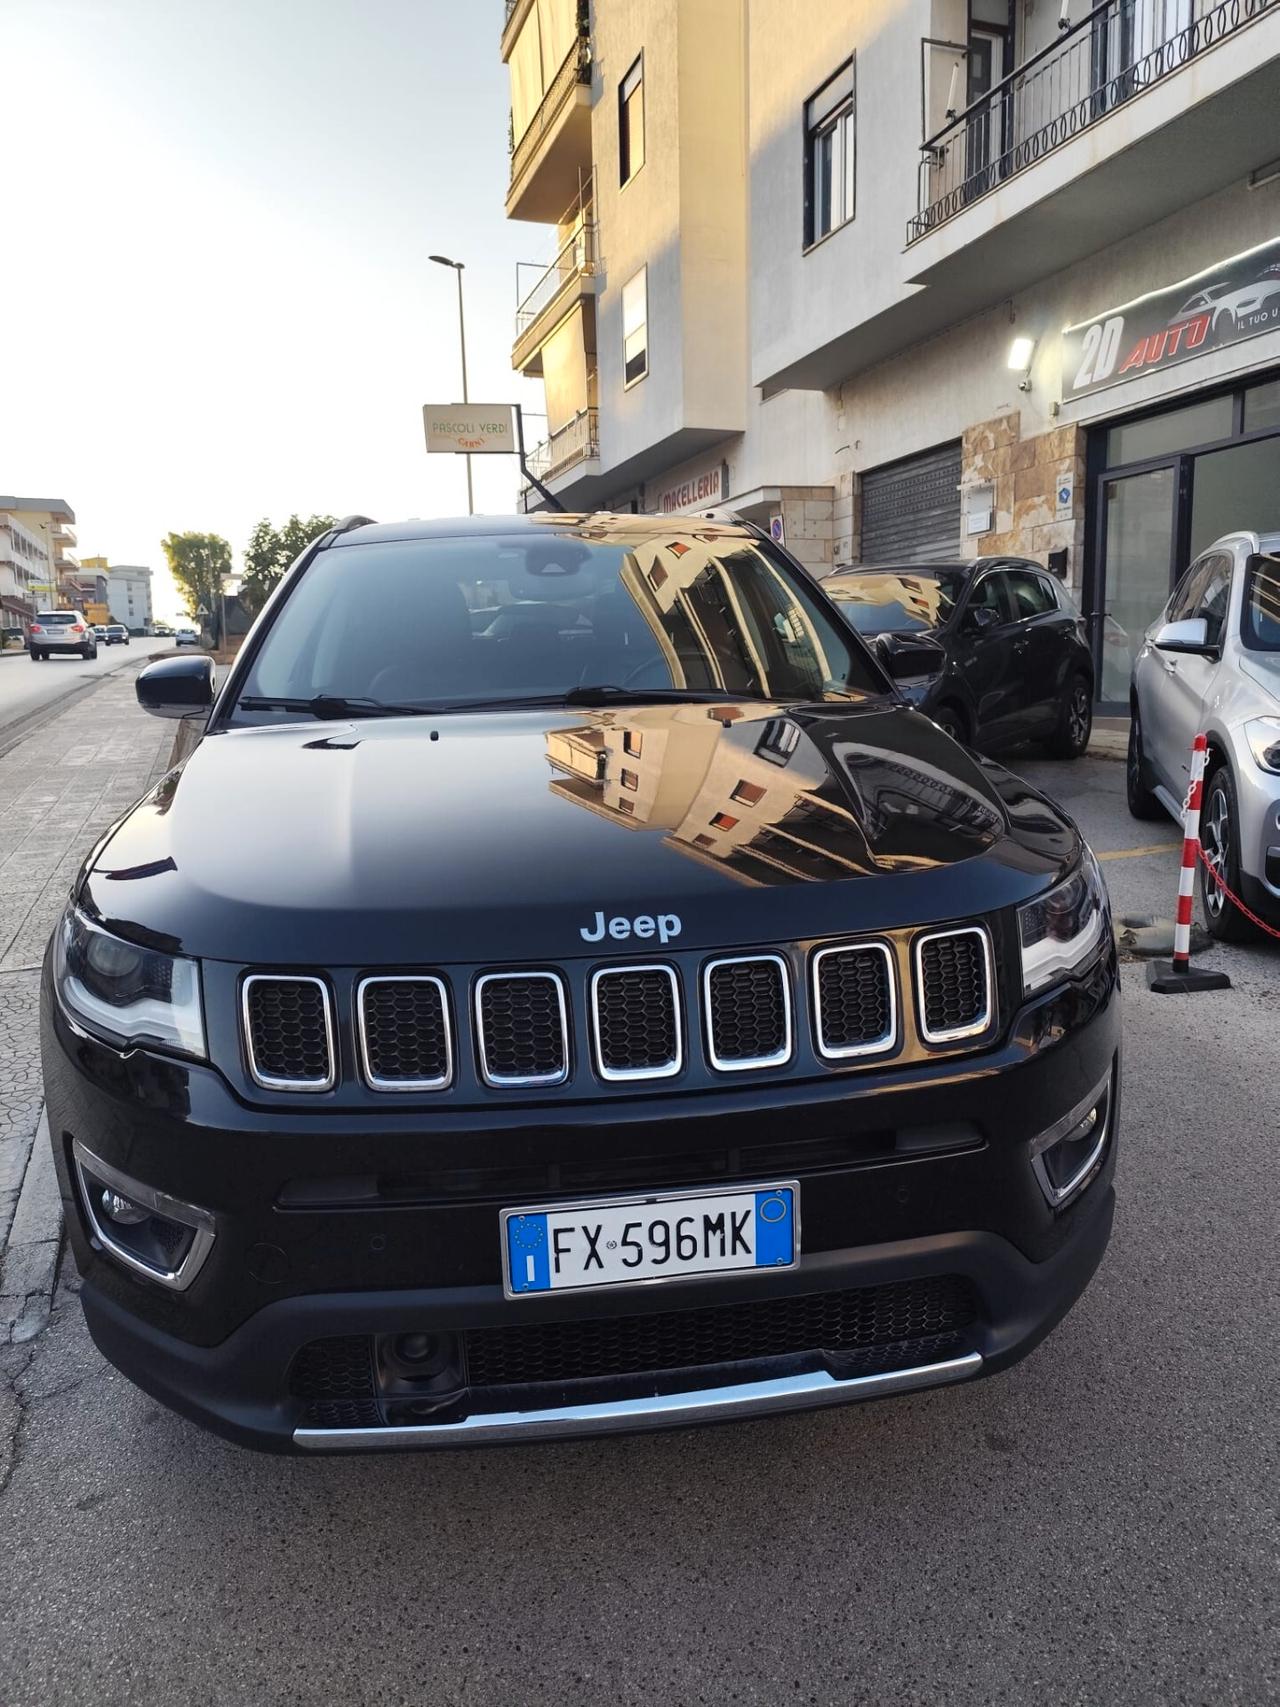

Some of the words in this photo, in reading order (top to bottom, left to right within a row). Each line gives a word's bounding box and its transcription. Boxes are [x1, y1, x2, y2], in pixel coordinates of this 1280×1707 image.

[1237, 321, 1246, 330] IL
[1248, 312, 1269, 326] TUO
[1271, 307, 1280, 317] U
[1117, 313, 1211, 375] AUTO
[432, 422, 475, 434] PASCOLI
[479, 422, 508, 434] VERDI
[663, 470, 720, 514] MACELLERIA
[579, 911, 682, 944] Jeep
